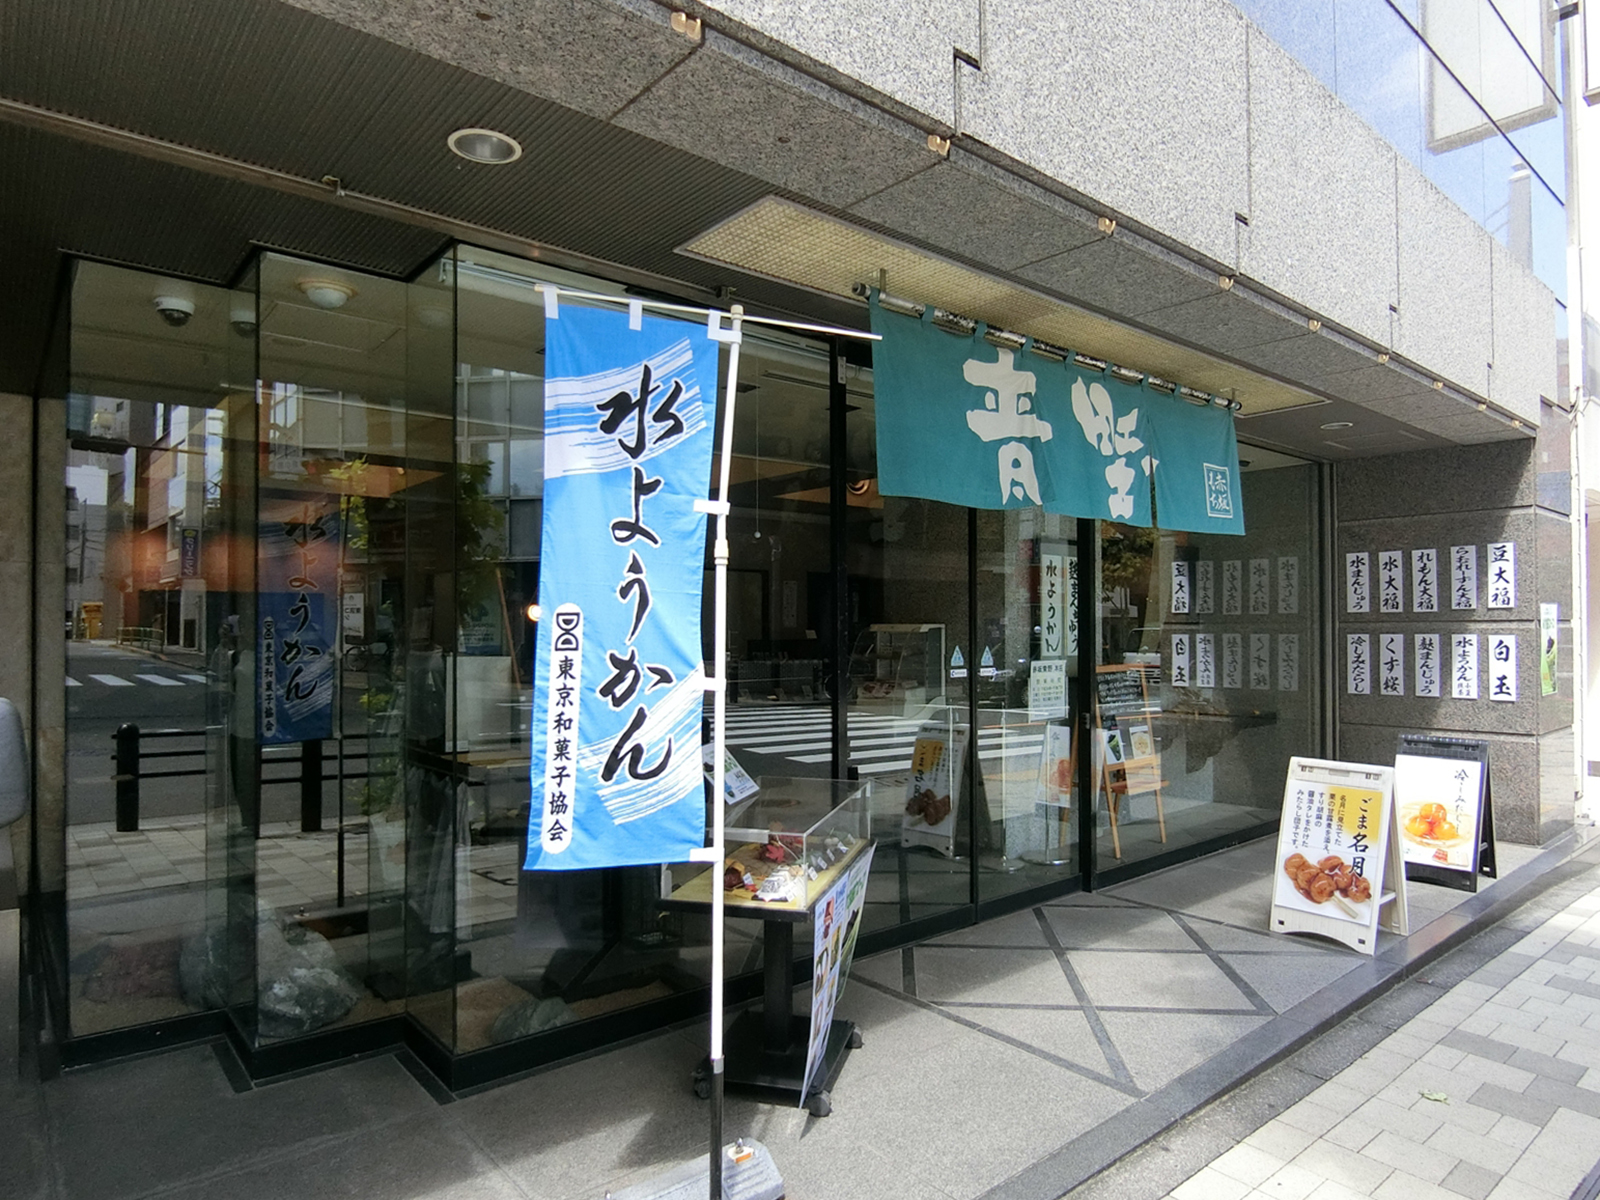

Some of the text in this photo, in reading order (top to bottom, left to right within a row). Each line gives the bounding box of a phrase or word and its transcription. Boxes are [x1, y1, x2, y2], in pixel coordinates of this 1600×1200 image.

[597, 364, 684, 782] 水ようかん
[1349, 555, 1366, 611] 水まんじゅう
[1382, 555, 1399, 611] 水大福
[1417, 552, 1434, 611] れもん大福
[1491, 544, 1511, 607] 豆大福
[280, 504, 326, 701] 水ようかん
[1045, 559, 1061, 653] 水ようかん
[1350, 635, 1367, 693] 冷しみたらし
[1383, 637, 1400, 694] くず桜
[1455, 636, 1473, 681] 水ようかん
[1493, 639, 1512, 696] 白玉
[547, 655, 576, 842] 東京和菓子協会
[1334, 794, 1347, 847] 名月に見立てた
[1347, 797, 1373, 878] ごま名月
